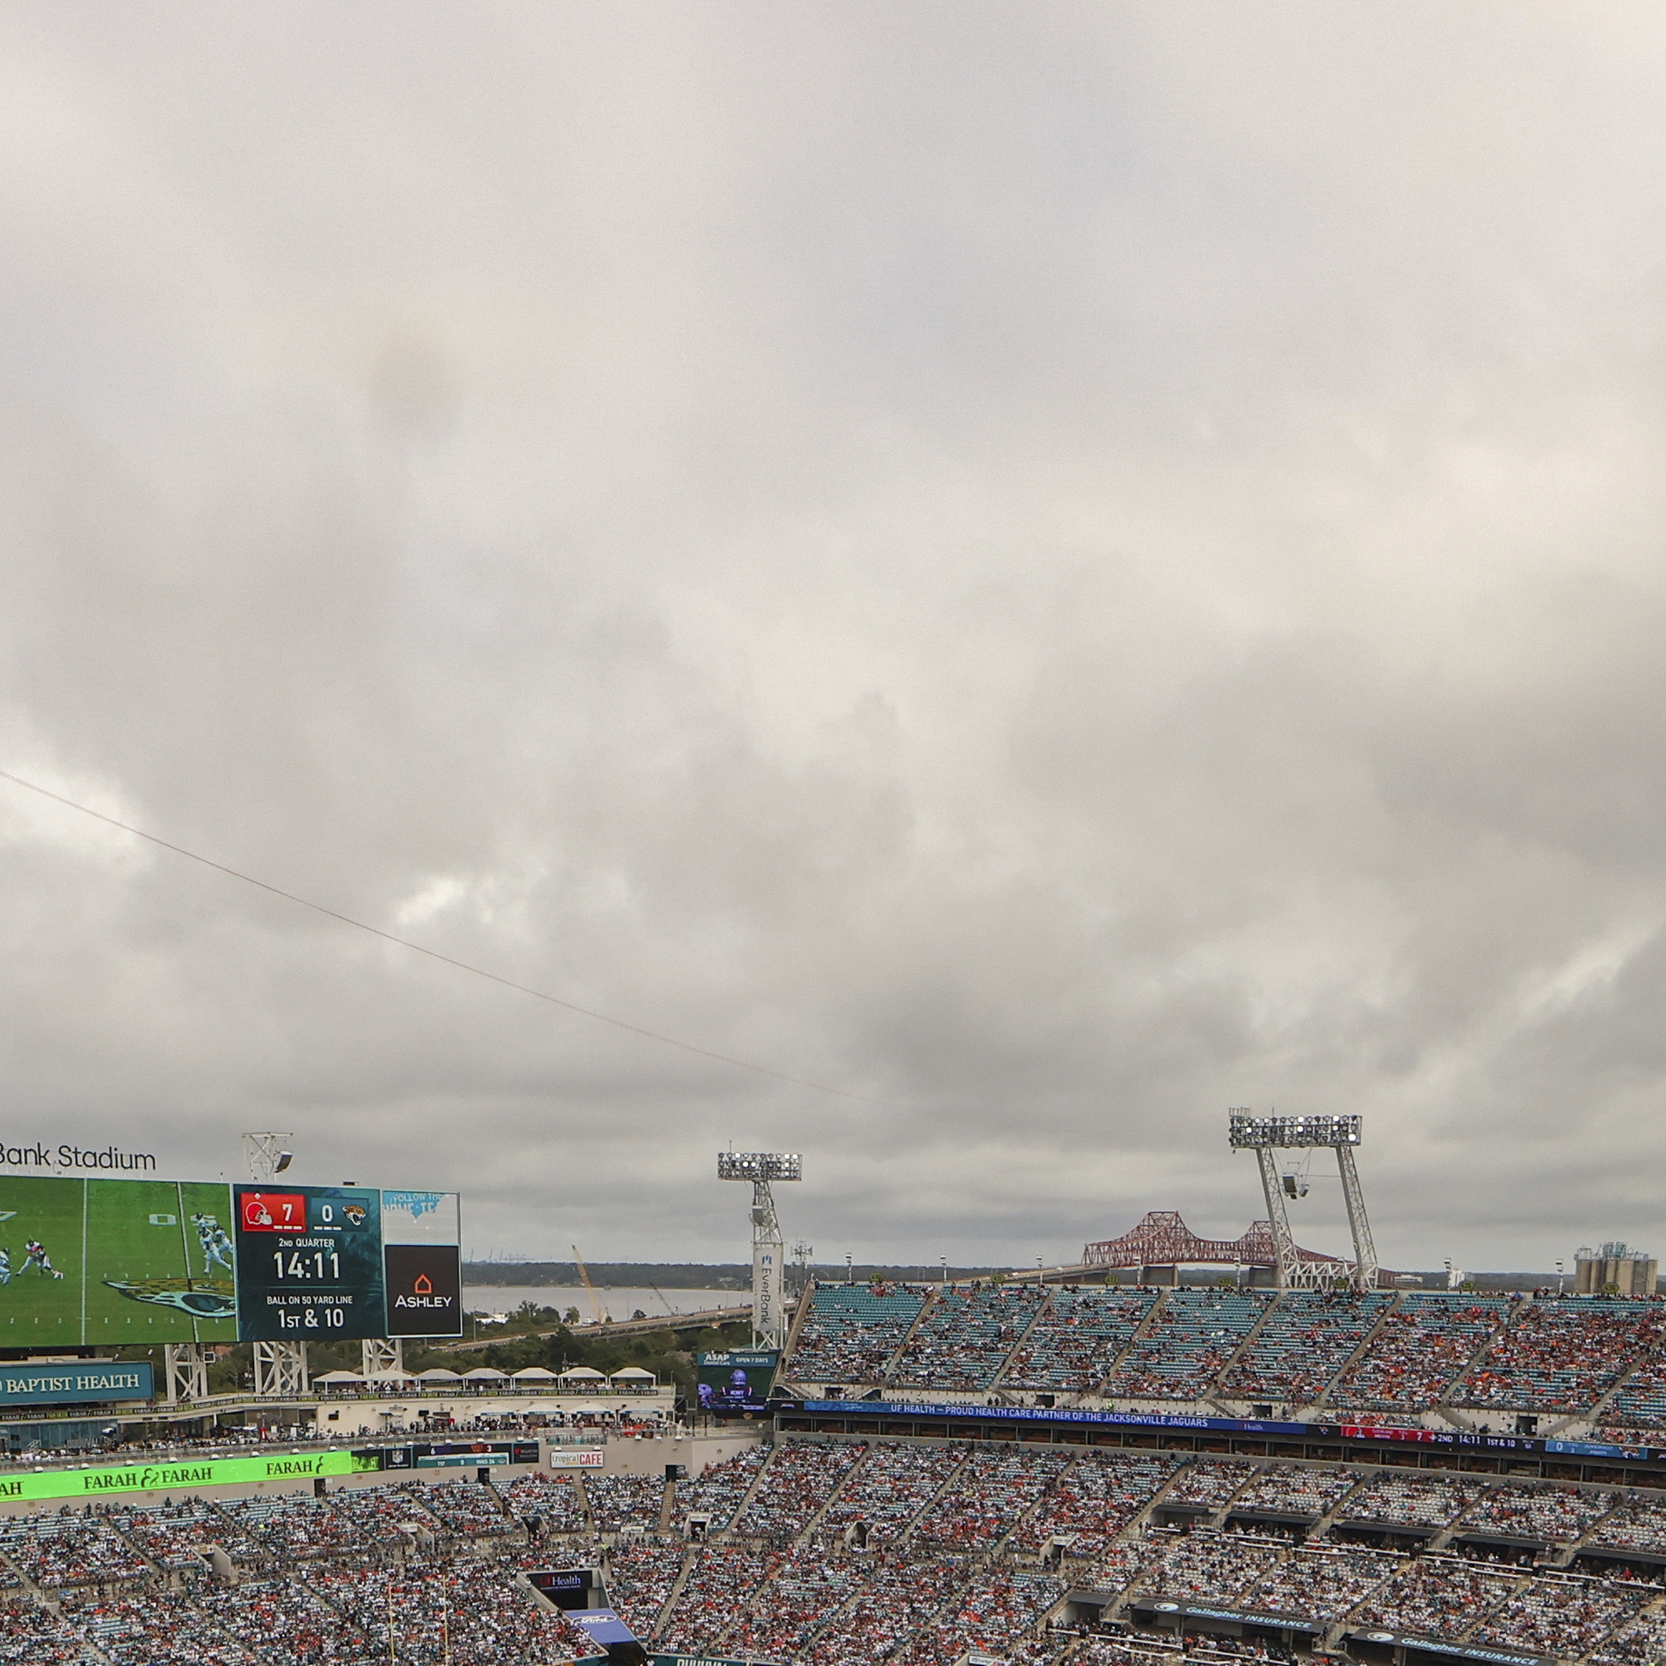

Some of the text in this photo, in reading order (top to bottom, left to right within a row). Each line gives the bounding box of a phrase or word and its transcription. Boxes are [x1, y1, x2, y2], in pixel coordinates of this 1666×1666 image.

[58, 1145, 157, 1171] Stadium
[282, 1203, 333, 1223] 7 0
[278, 1237, 335, 1248] 2ND QUARTER
[273, 1251, 340, 1279] 14:11
[267, 1295, 353, 1305] BALL ON 50 YARD LINE
[395, 1295, 452, 1308] ASHLEY
[278, 1308, 344, 1328] 1ST & 10
[6, 1374, 140, 1394] BAPTIST HEALTH
[890, 1404, 1208, 1428] UF HEALTH PROUD HEALTH CARE PARTNER OF THE JACKSONVILLE JAGUARS
[266, 1460, 313, 1477] FARAH
[579, 1453, 602, 1466] CAFE
[84, 1473, 137, 1490] FARAH
[161, 1467, 213, 1484] FARAH
[551, 1574, 582, 1587] Health
[1186, 1606, 1312, 1630] Gallagher INSURANCE
[1401, 1637, 1540, 1666] Gallagher INSURANCE
